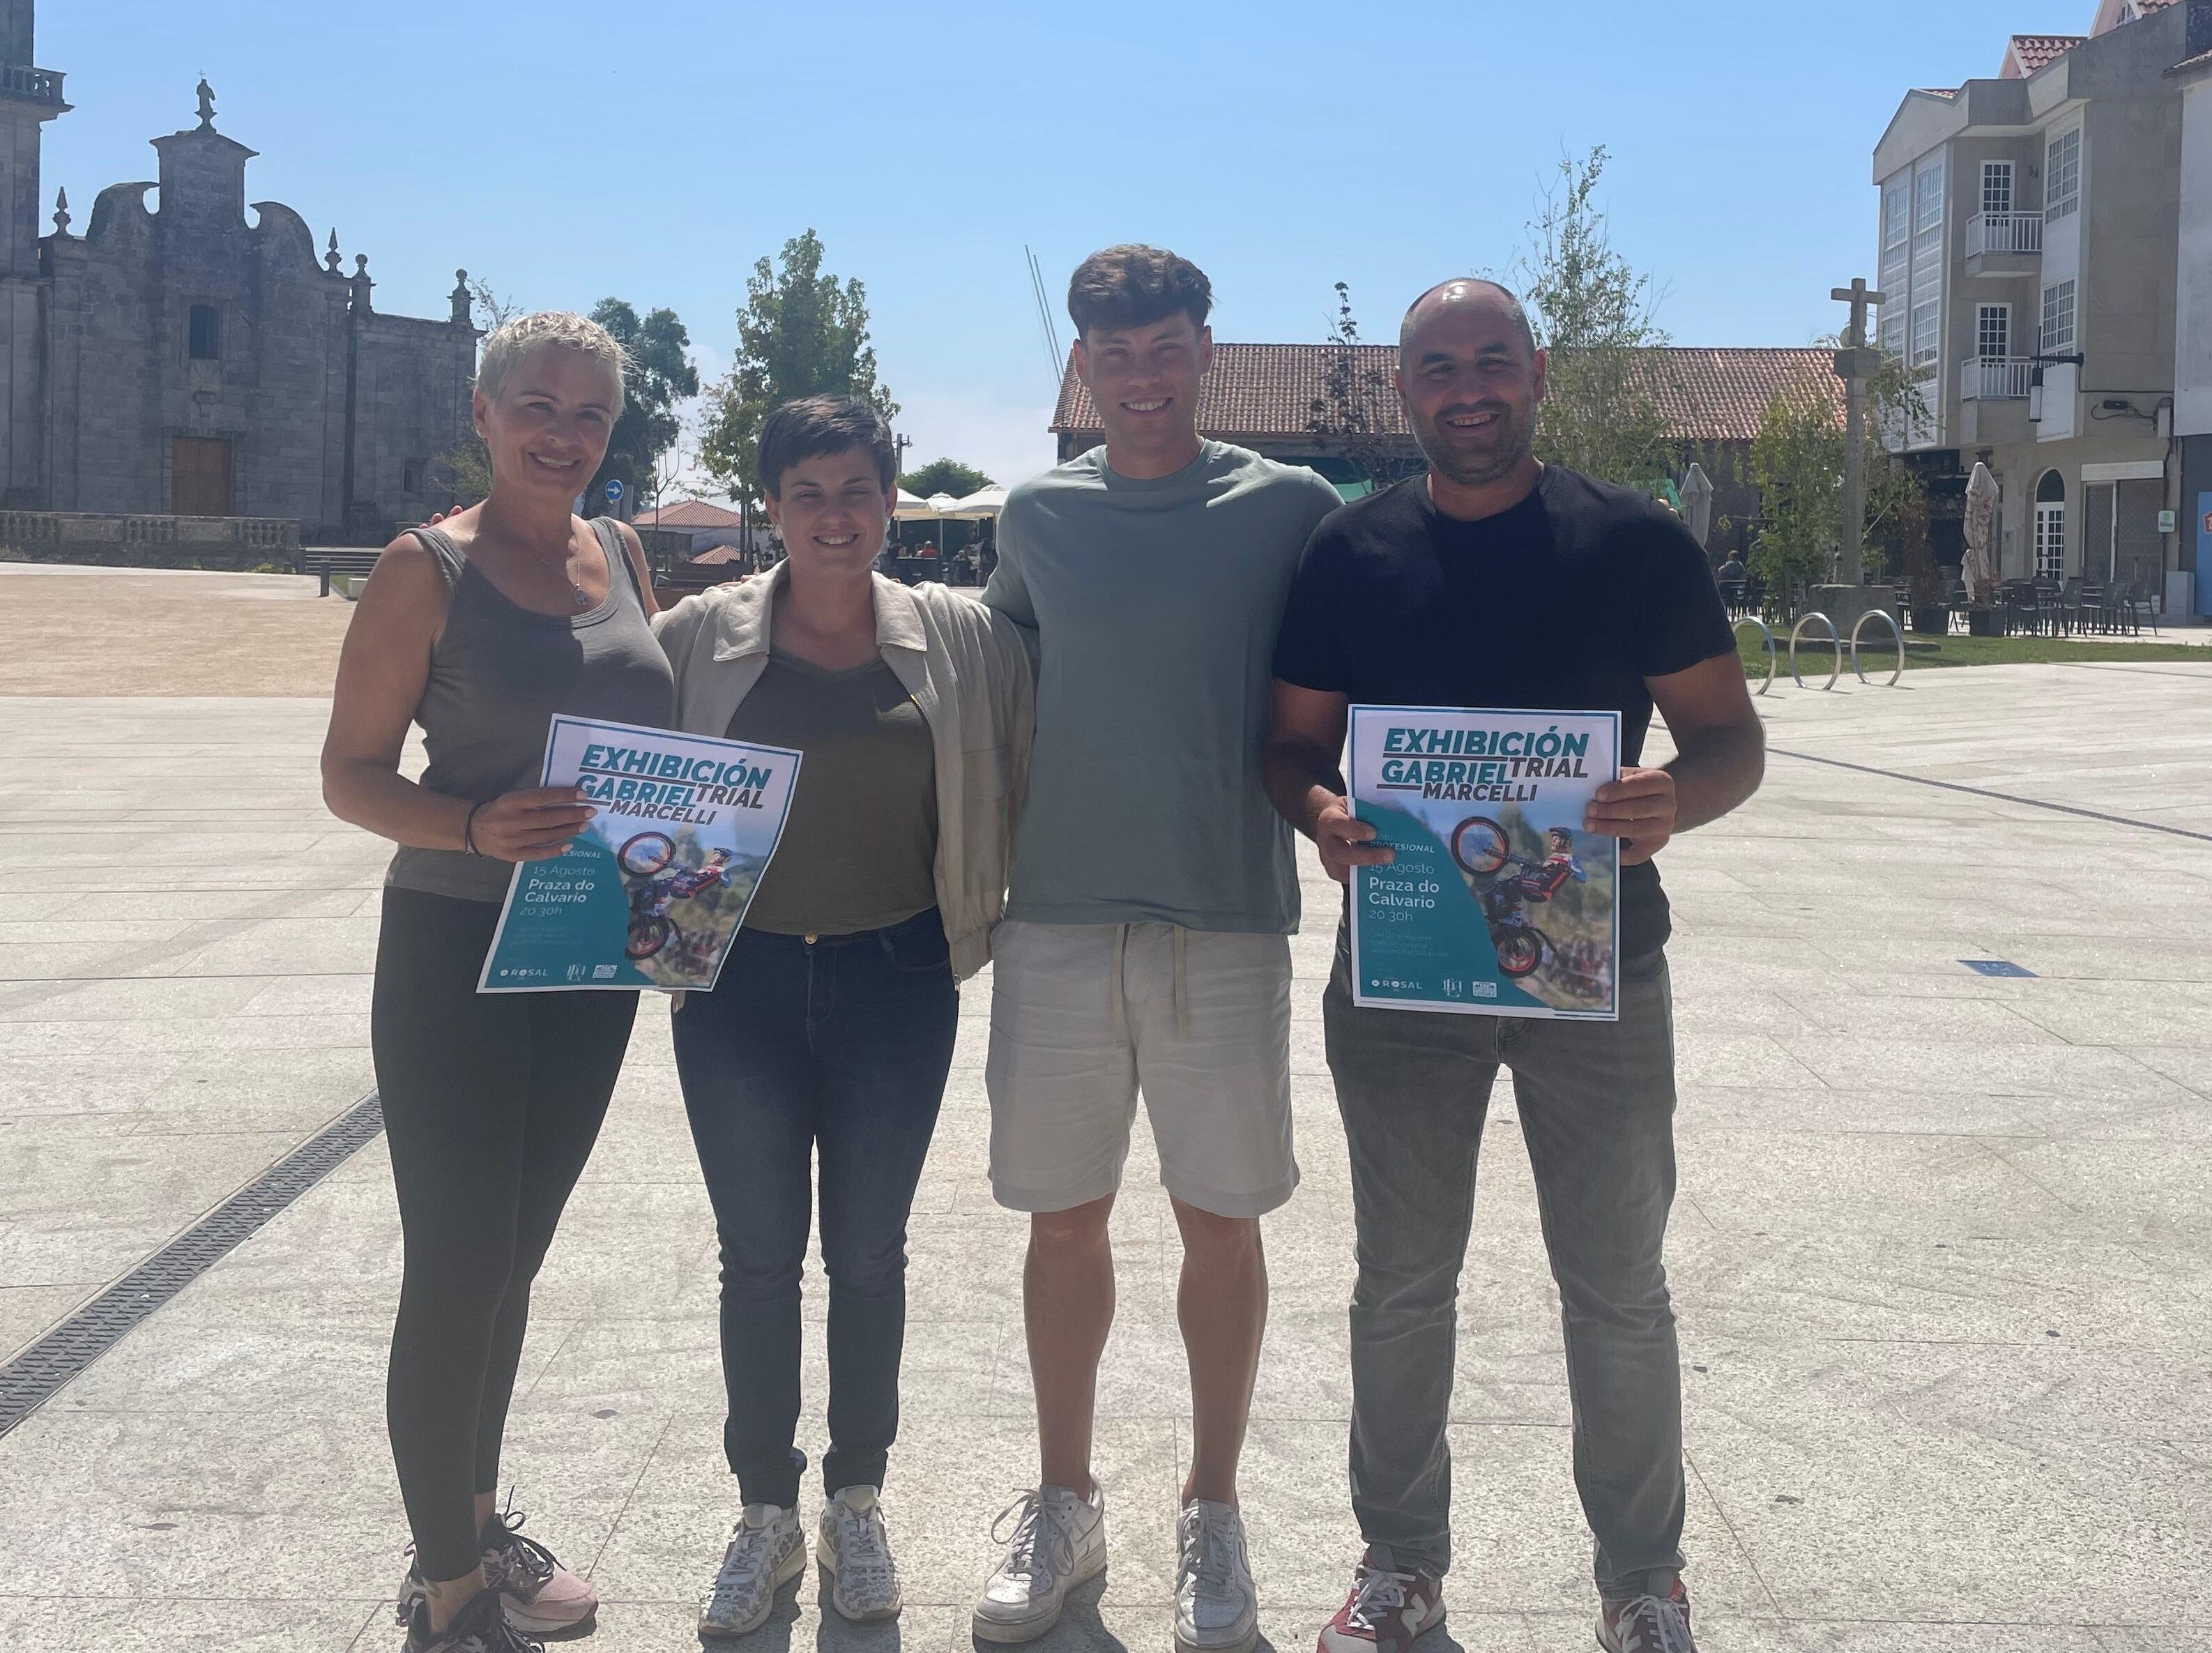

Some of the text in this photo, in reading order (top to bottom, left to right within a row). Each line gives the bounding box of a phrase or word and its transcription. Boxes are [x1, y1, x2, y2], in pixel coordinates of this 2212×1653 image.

[1384, 726, 1589, 759] EXHIBICIÓN
[581, 744, 772, 789] EXHIBICIÓN
[1382, 760, 1513, 784] GABRIEL
[1509, 757, 1588, 778] TRIAL
[575, 775, 697, 808] GABRIEL
[696, 784, 763, 809] TRIAL
[1422, 782, 1538, 802] MARCELLI
[609, 800, 717, 825] MARCELLI
[533, 865, 595, 877] 15 Agosto
[1387, 861, 1434, 875] Agosto
[528, 878, 595, 890] Praza do
[1369, 877, 1439, 893] Praza do
[525, 892, 586, 902] Calvario
[1369, 892, 1435, 908] Calvario
[1382, 980, 1423, 989] ROSAL
